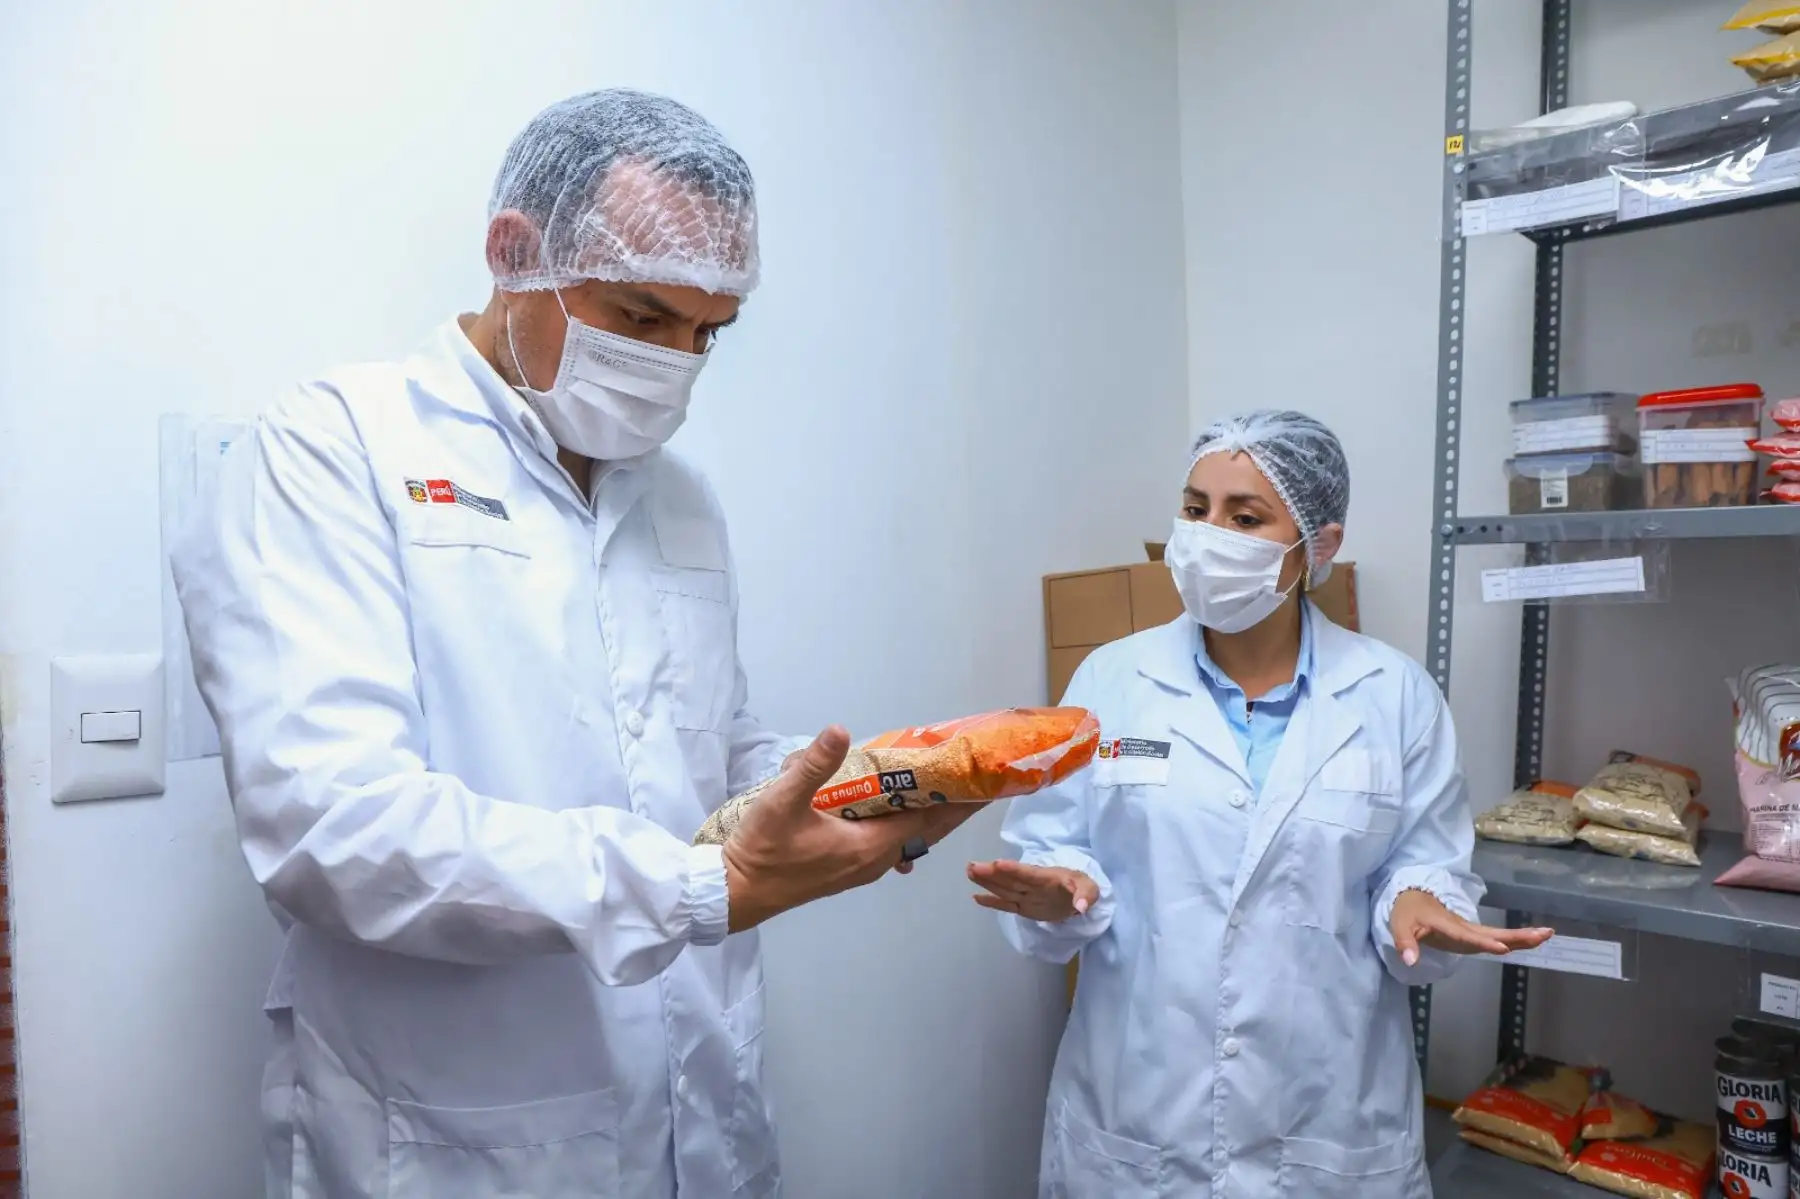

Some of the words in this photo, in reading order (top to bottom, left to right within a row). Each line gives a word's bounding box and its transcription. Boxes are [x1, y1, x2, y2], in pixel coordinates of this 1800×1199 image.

[832, 780, 873, 802] Quinua
[882, 773, 913, 790] aro
[1717, 1076, 1783, 1105] GLORIA
[1728, 1123, 1777, 1144] LECHE
[1720, 1151, 1773, 1188] LORIA
